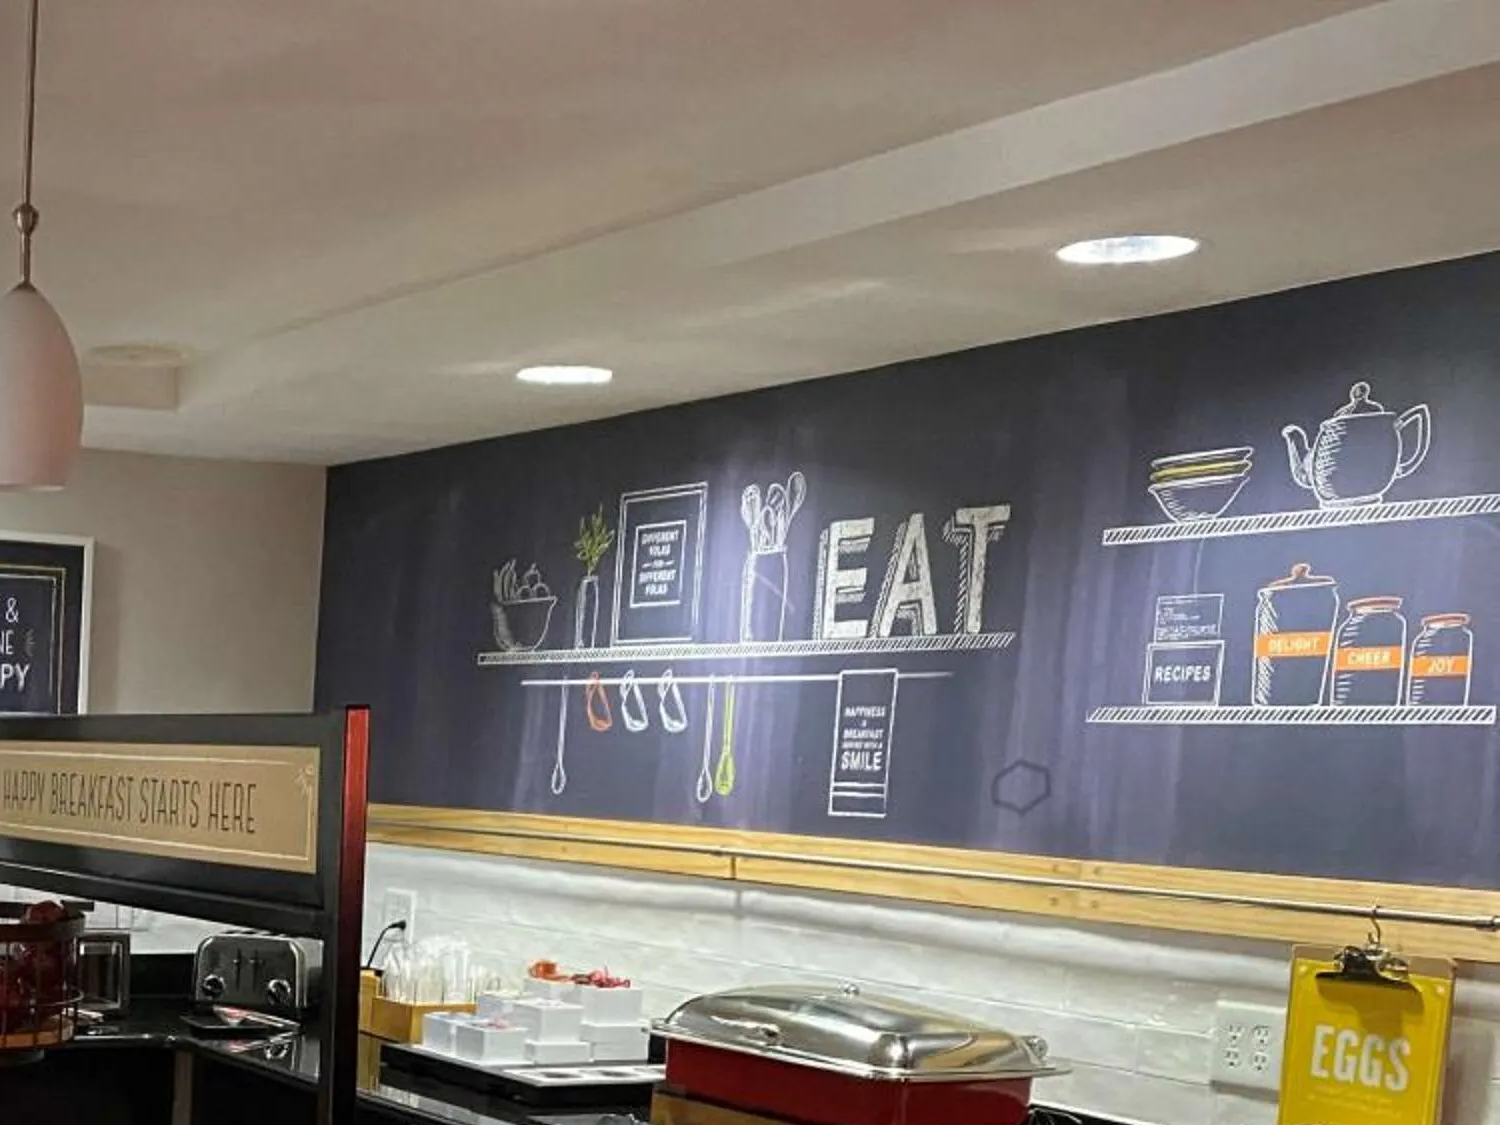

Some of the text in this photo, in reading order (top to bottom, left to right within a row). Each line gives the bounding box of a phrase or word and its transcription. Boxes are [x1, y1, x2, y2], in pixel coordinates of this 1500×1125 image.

[814, 504, 1012, 640] EAT
[5, 596, 19, 623] &
[1267, 636, 1320, 654] DELIGHT
[1347, 650, 1392, 666] CHEER
[1427, 658, 1455, 673] JOY
[1155, 665, 1211, 683] RECIPES
[841, 751, 883, 771] SMILE
[3, 770, 256, 835] HAPPY BREAKFAST STARTS HERE
[1309, 1025, 1411, 1093] EGGS
